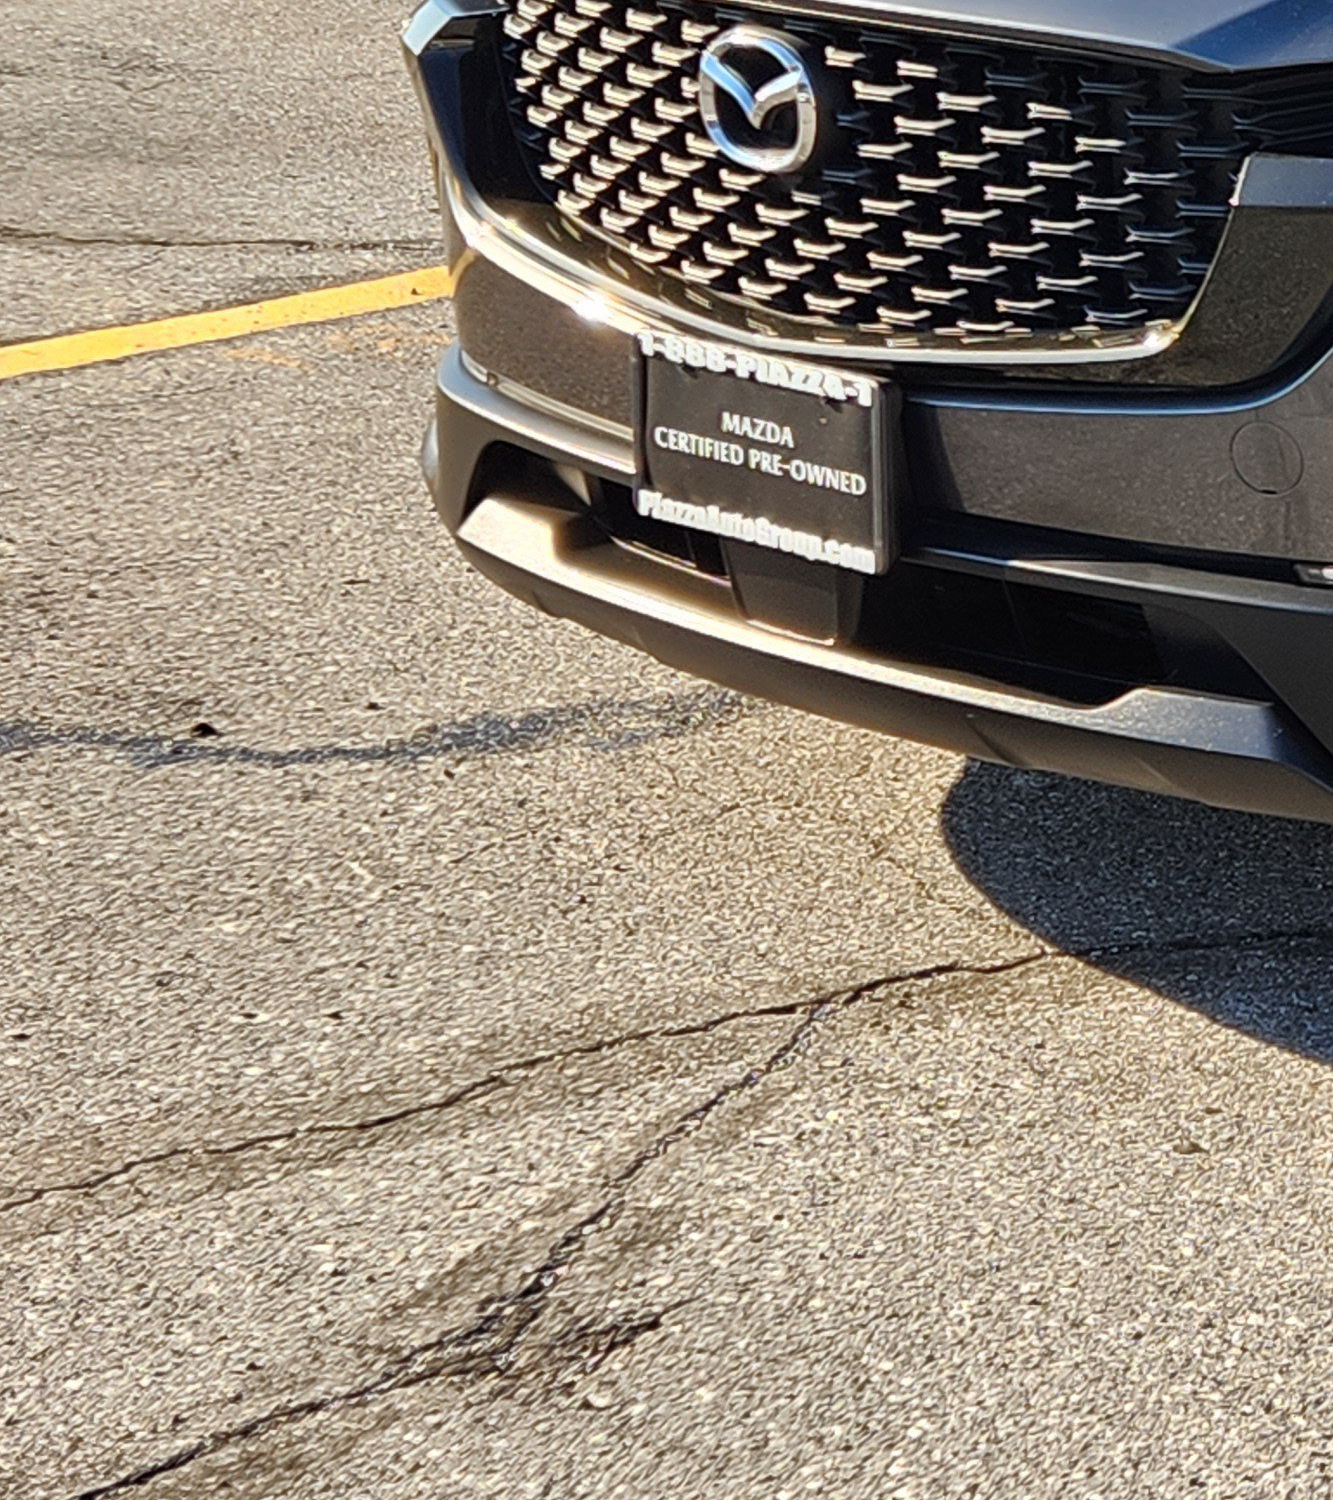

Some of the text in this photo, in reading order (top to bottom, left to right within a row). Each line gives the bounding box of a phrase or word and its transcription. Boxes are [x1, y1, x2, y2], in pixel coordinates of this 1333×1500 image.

[637, 332, 872, 407] 1-888-PIAZZA-1
[653, 426, 867, 497] CERTIFIED PRE-OWNED
[720, 411, 794, 449] MAZDA
